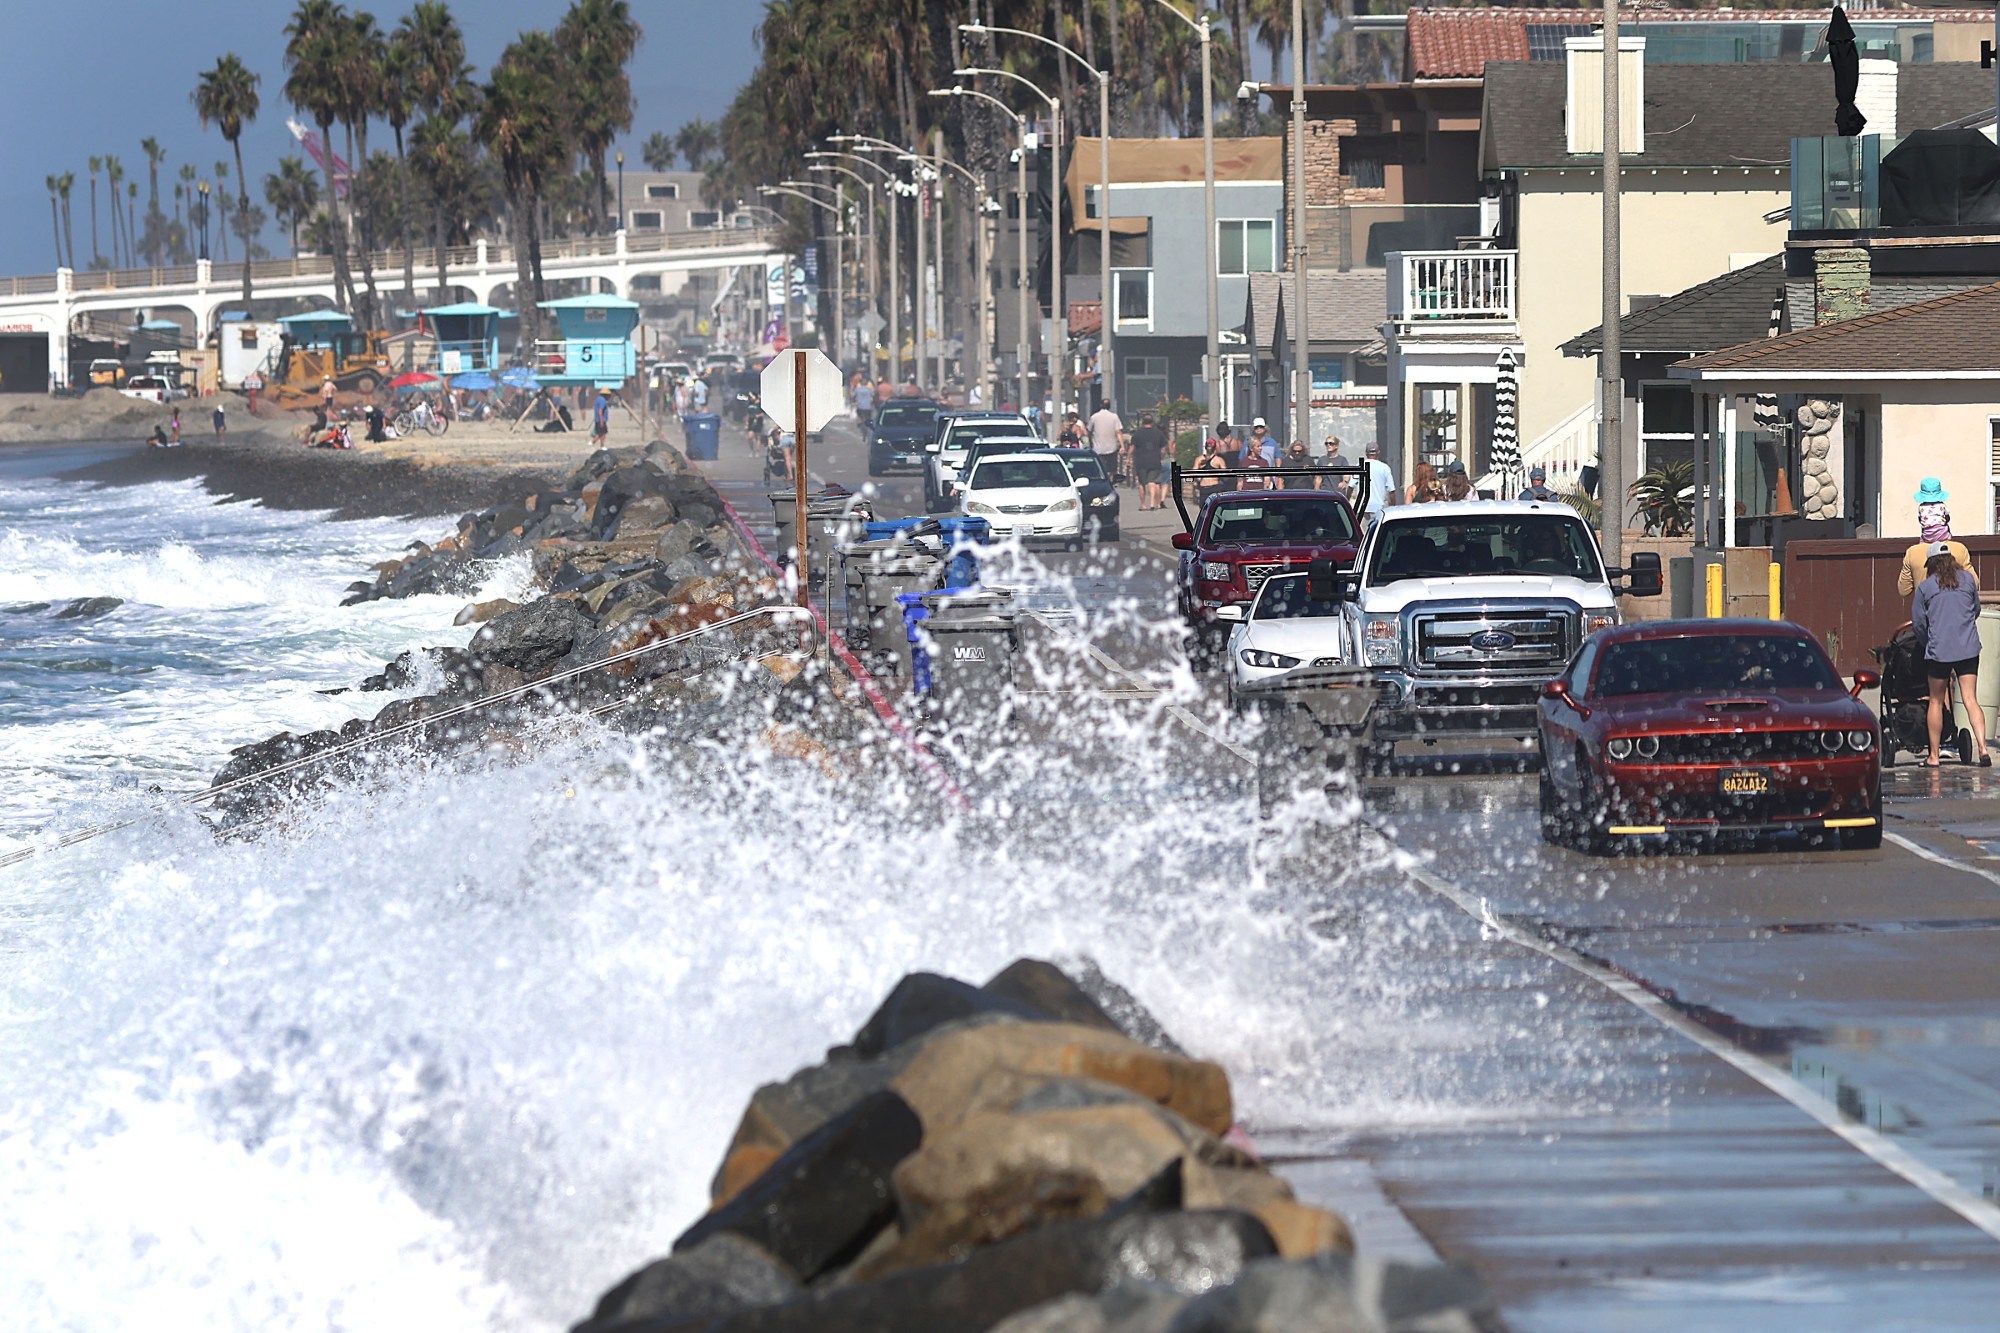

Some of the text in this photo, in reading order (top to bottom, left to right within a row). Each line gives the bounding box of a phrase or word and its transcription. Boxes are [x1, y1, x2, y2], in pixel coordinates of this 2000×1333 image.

[581, 345, 593, 363] 5
[1481, 635, 1505, 646] Ford
[953, 647, 986, 659] WM
[1724, 777, 1768, 792] 8A24A12
